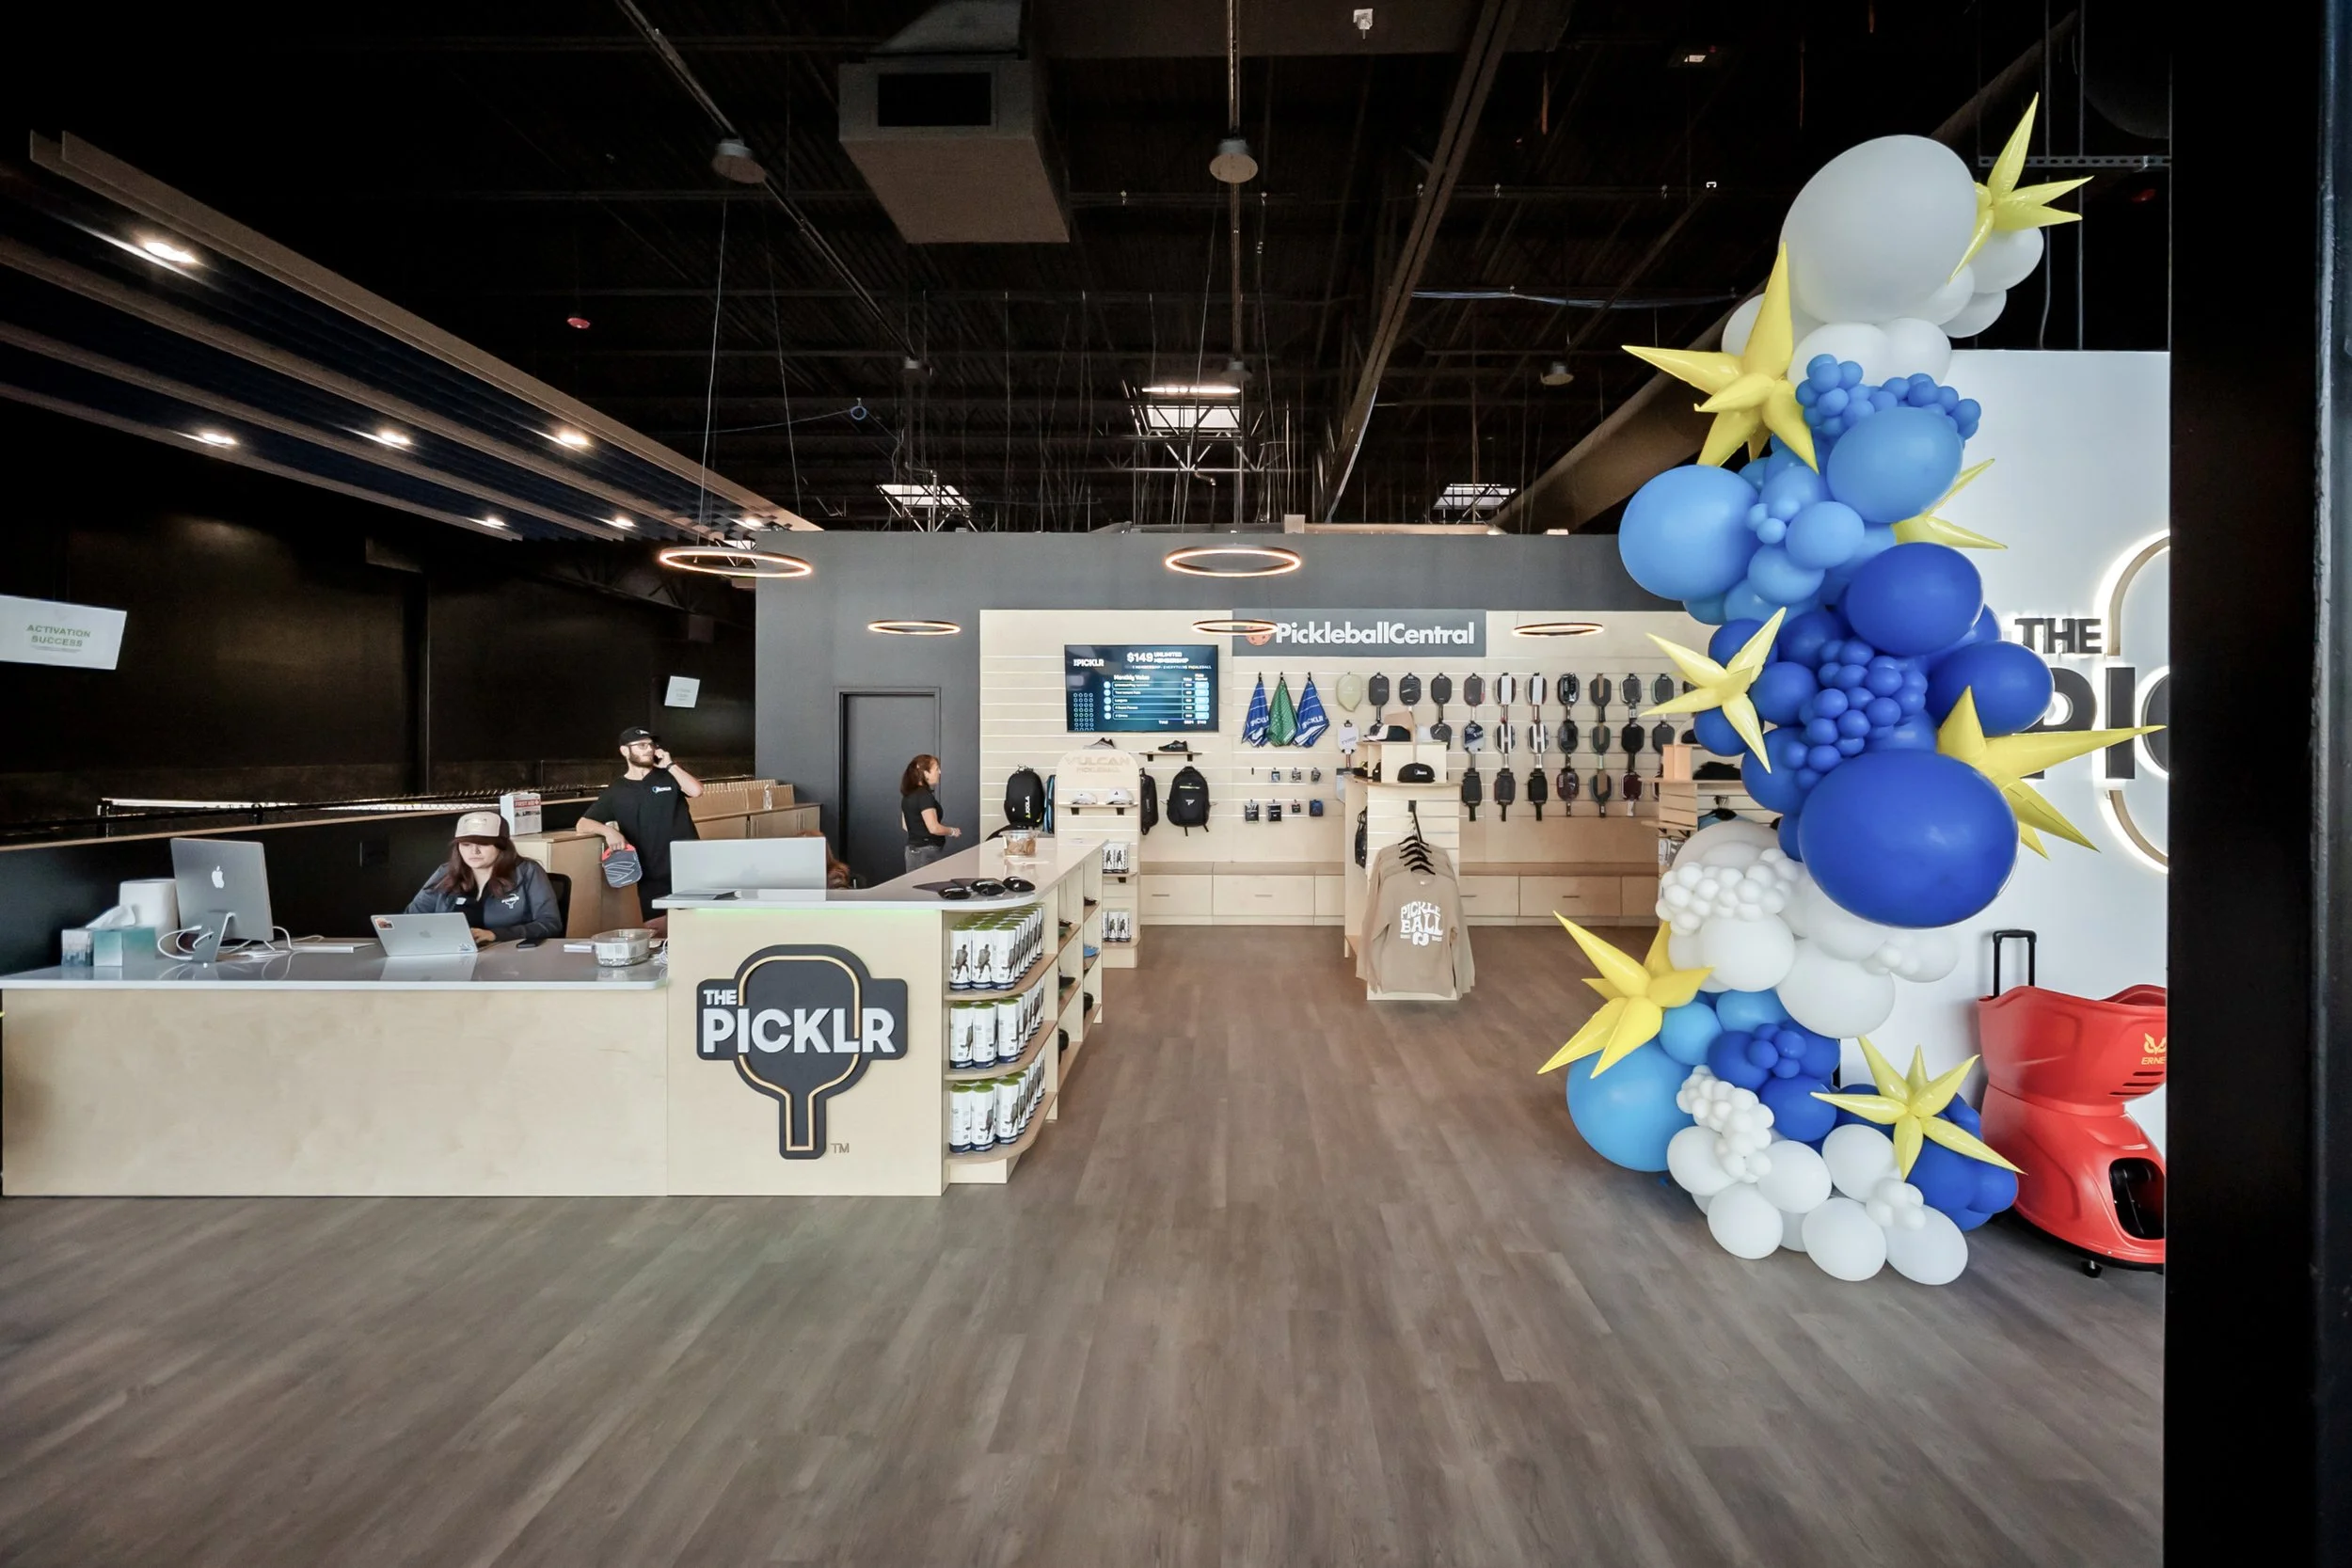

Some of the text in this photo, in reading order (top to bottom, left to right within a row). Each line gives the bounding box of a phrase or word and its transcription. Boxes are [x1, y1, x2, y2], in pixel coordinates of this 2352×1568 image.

[25, 624, 91, 638] ACTIVATION
[1276, 621, 1475, 644] PickleballCentral
[2014, 618, 2103, 655] THE
[31, 635, 83, 647] SUCCESS
[1077, 658, 1104, 667] PICKLR
[1127, 652, 1153, 662] $149
[1400, 901, 1441, 919] PICKLE
[1400, 913, 1444, 937] BALL
[703, 990, 738, 1006] THE
[703, 1007, 897, 1053] PICKLR
[831, 1143, 850, 1154] TM
